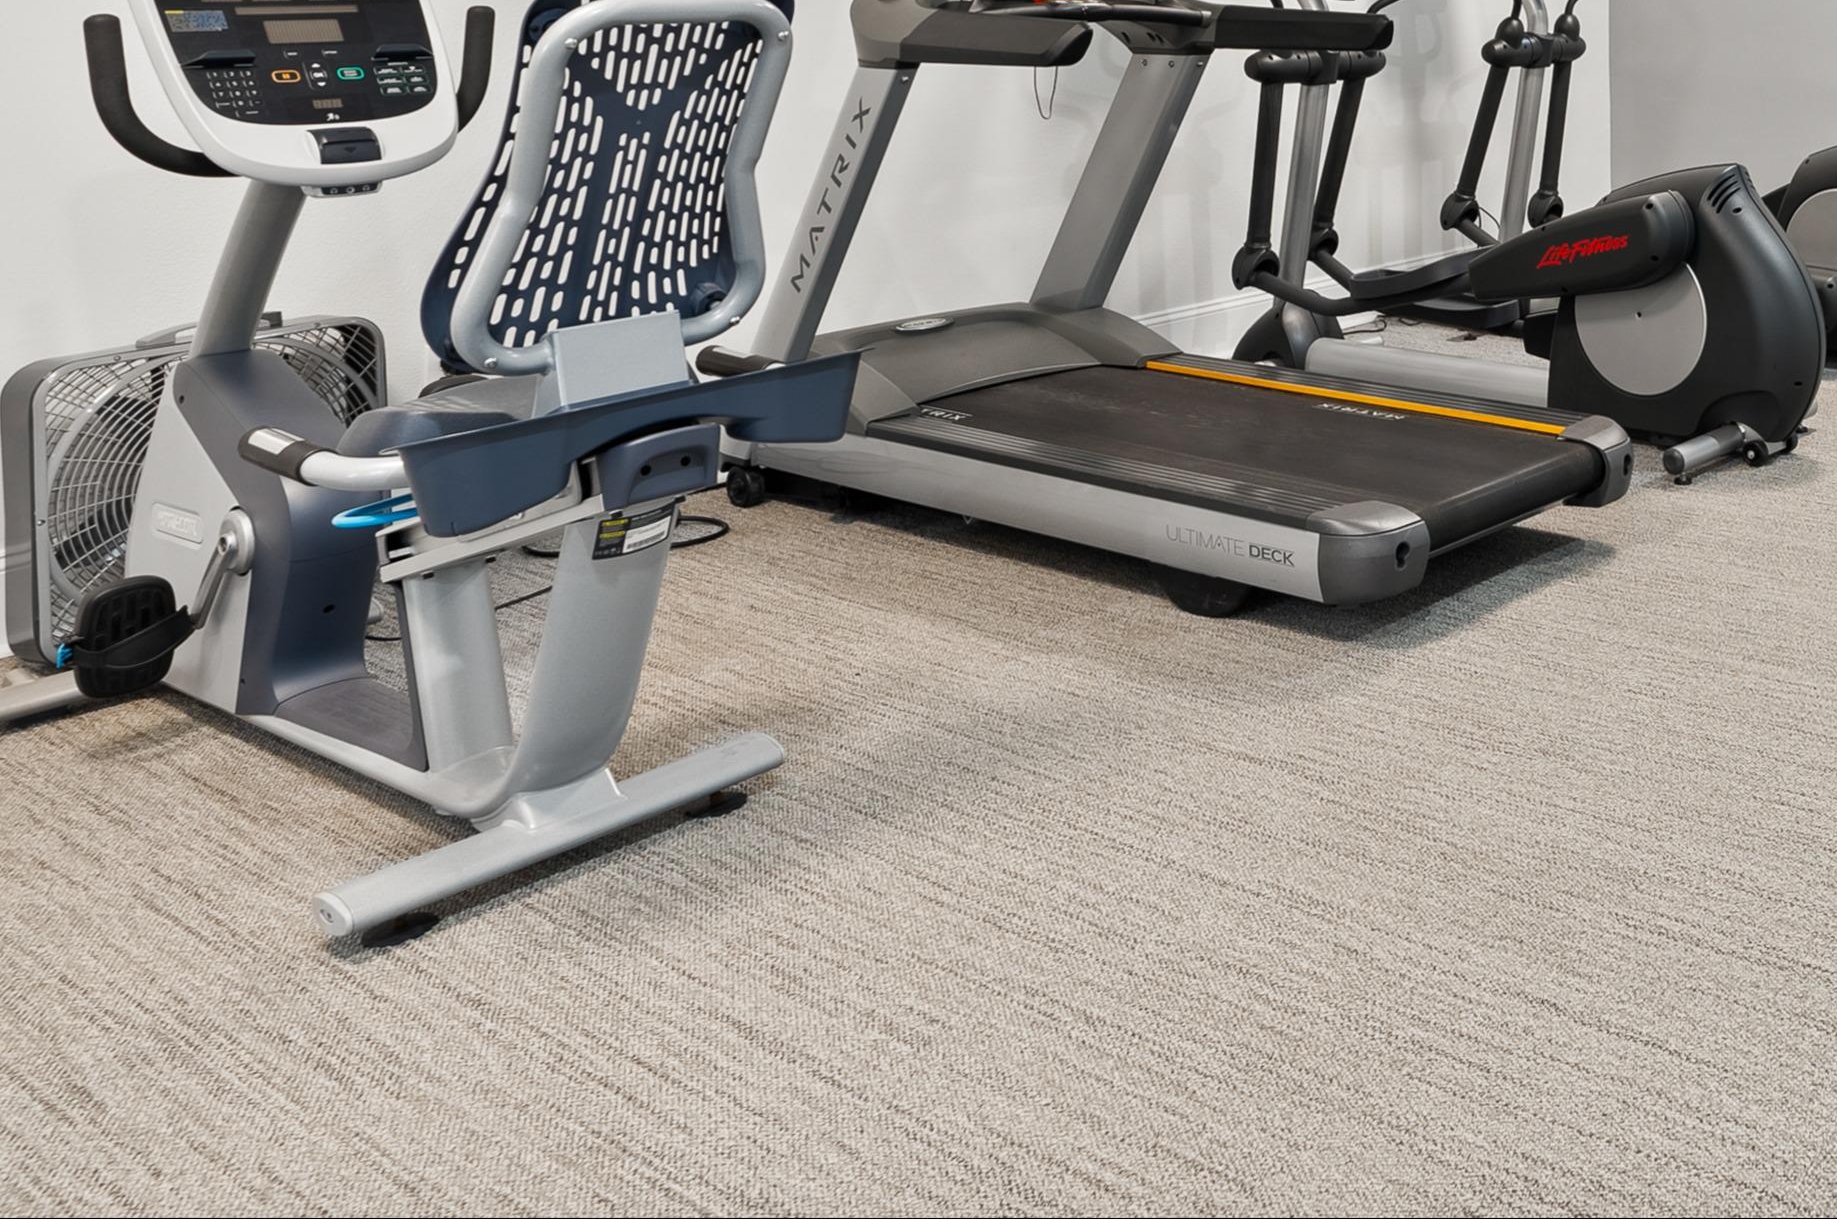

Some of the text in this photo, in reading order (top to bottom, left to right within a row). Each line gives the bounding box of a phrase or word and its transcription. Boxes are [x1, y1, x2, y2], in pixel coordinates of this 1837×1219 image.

[790, 96, 871, 293] MATRIX
[921, 408, 966, 421] TRIX
[1165, 524, 1296, 567] ULTIMATE DECK
